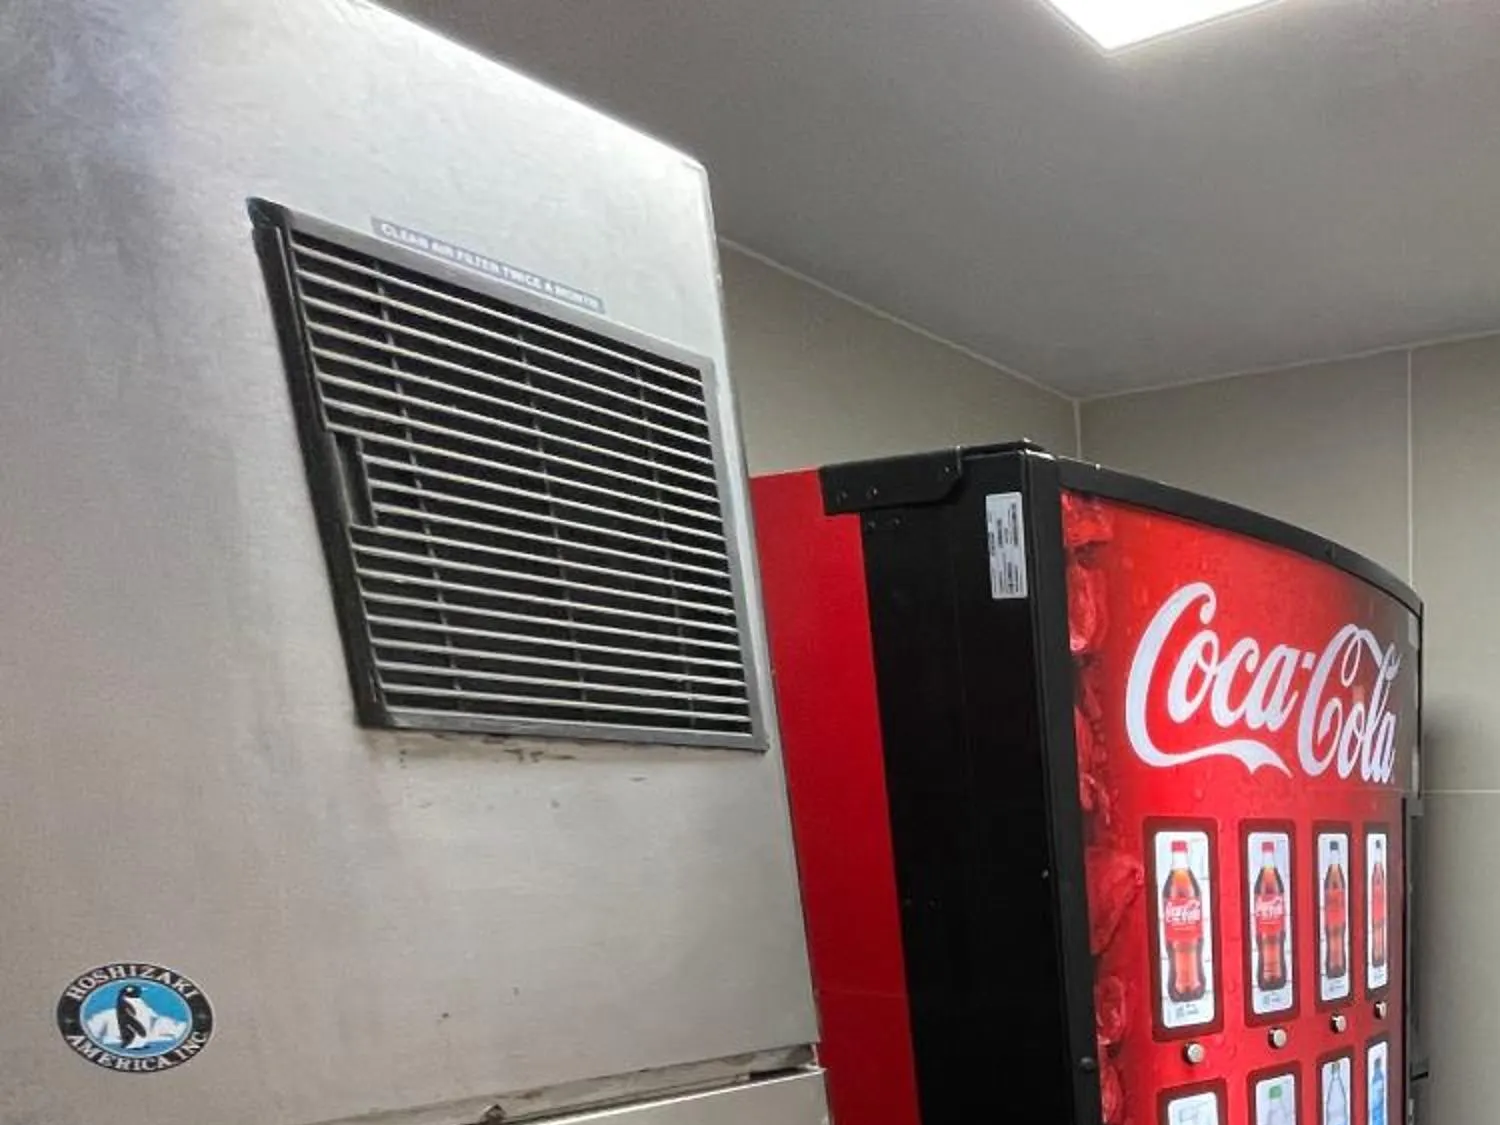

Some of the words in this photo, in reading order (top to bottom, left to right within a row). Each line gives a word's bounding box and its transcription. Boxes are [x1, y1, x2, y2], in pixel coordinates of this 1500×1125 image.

[381, 222, 429, 250] CLEAN
[431, 241, 455, 259] AIR
[456, 250, 501, 275] FILTER
[502, 265, 543, 291] TWICE
[1125, 581, 1398, 784] Coca-Cola
[66, 964, 198, 1001] HOSHIZAKI
